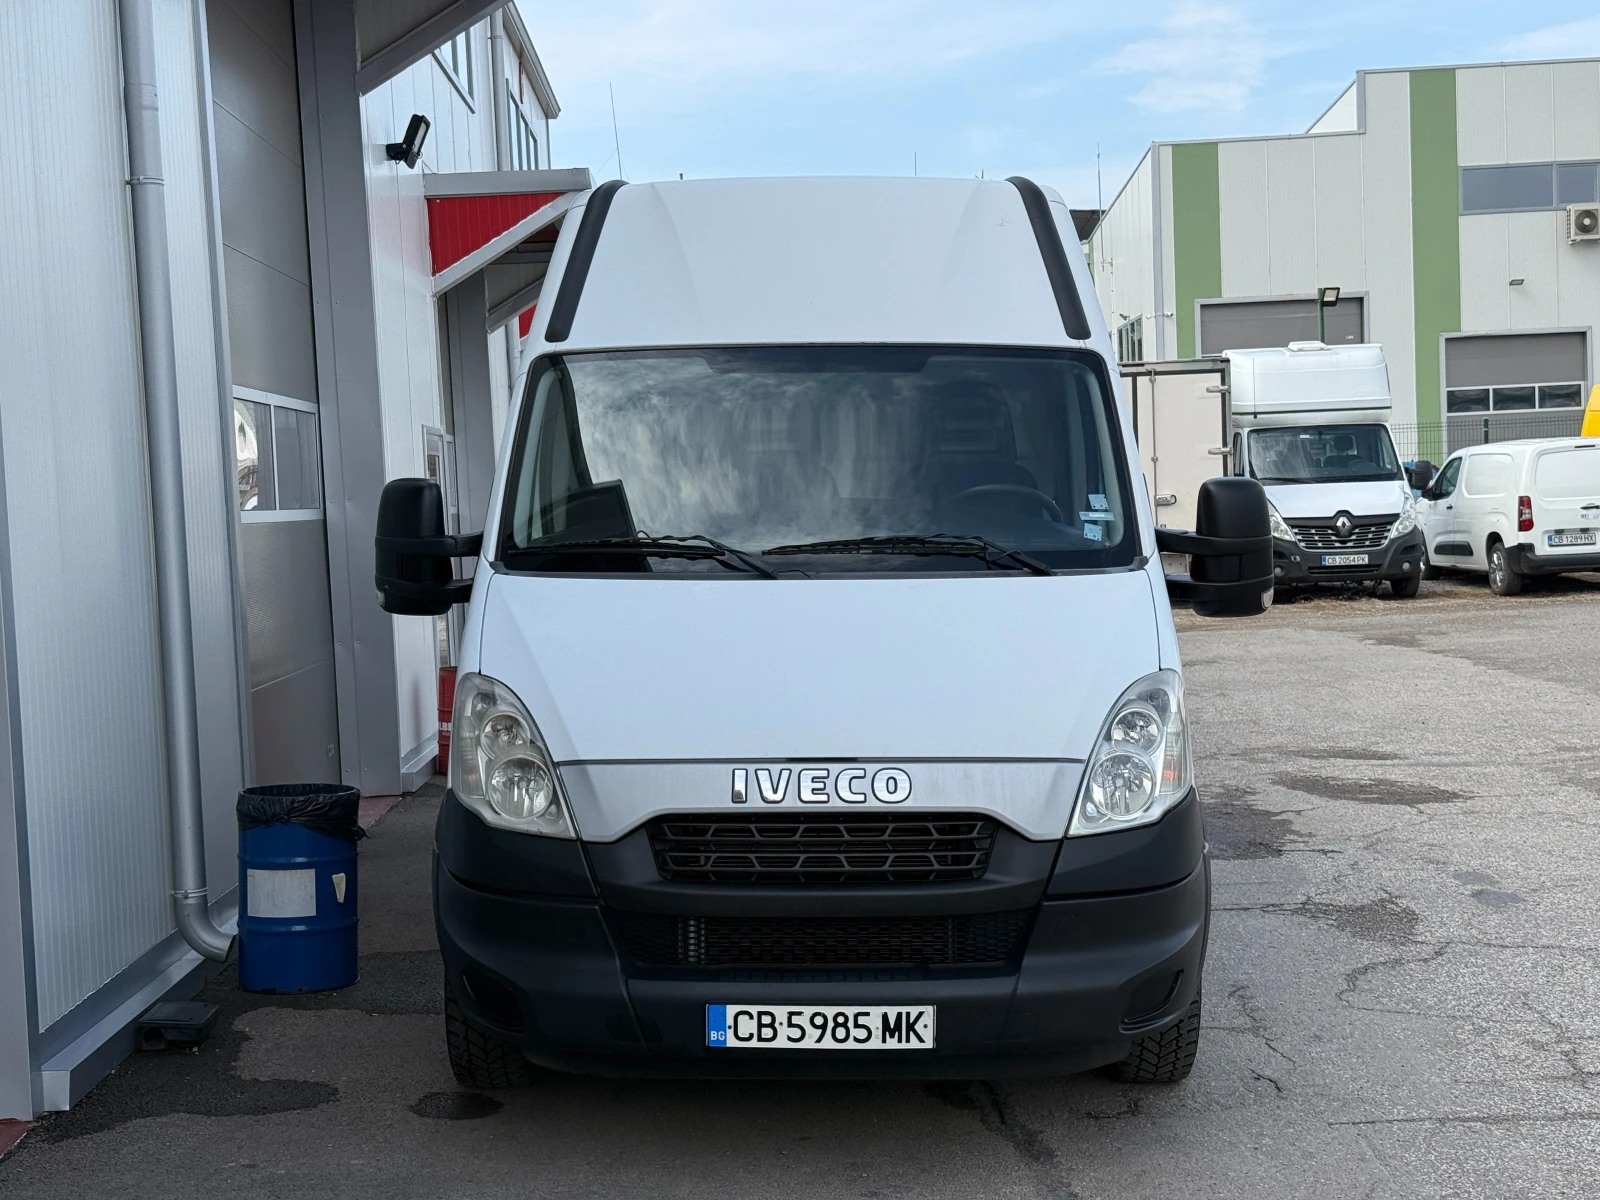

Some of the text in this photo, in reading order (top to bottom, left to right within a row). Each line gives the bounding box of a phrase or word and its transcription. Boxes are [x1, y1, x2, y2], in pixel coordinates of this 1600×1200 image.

[1553, 534, 1594, 544] CB 1289 HX
[1327, 555, 1367, 565] CB 2054 PK
[731, 767, 912, 804] IVECO
[733, 1010, 926, 1044] CB 5985 MK
[710, 1030, 725, 1041] BG
